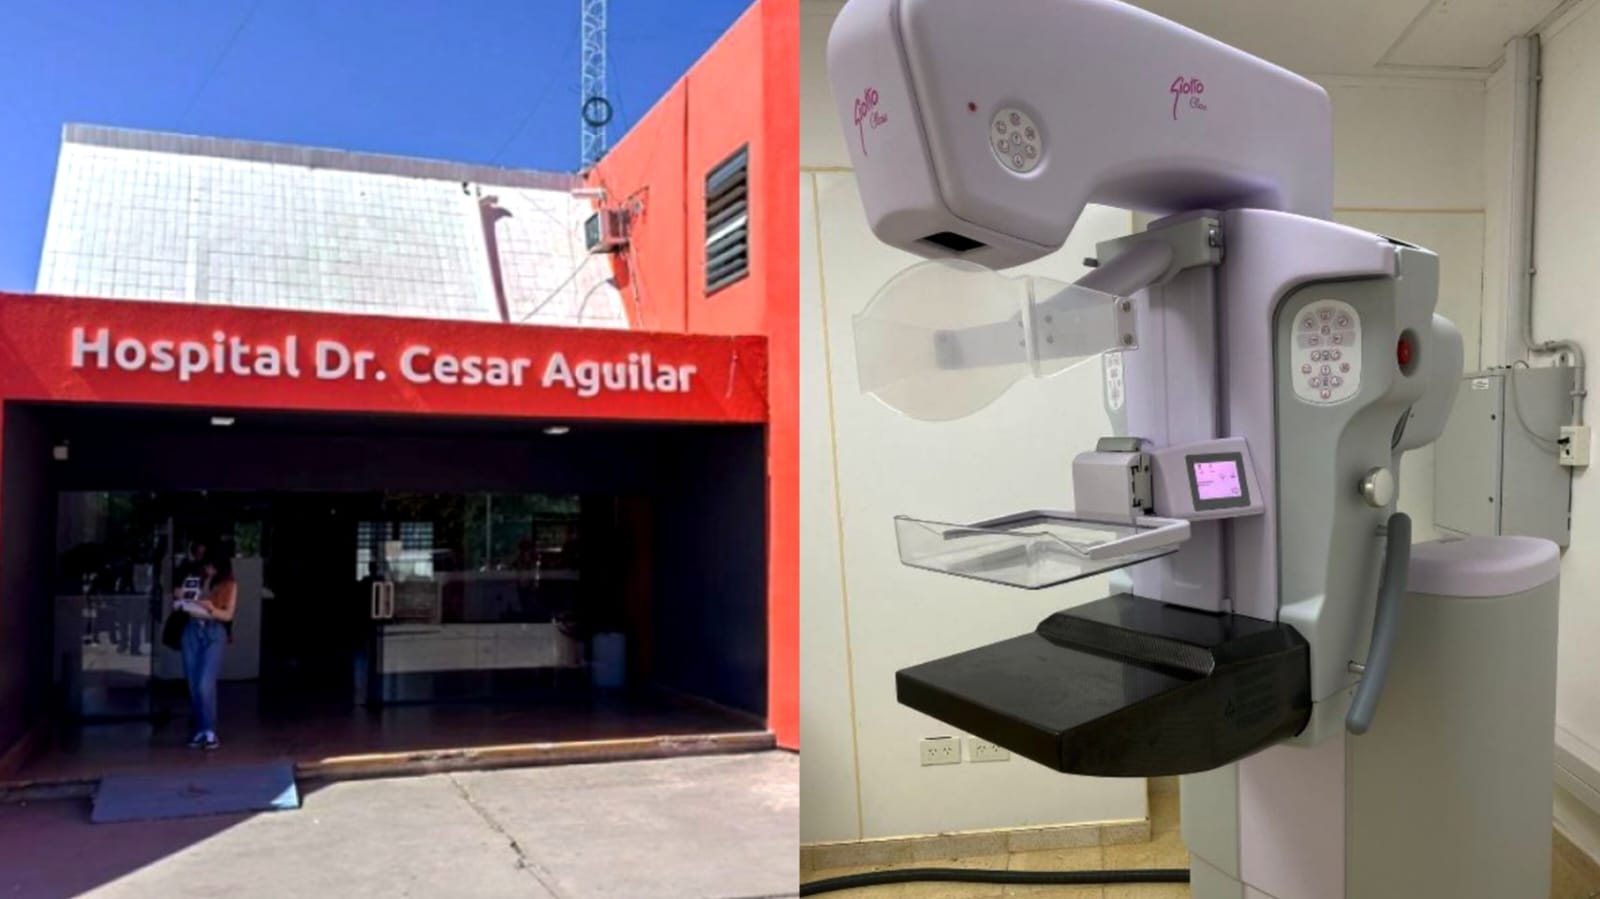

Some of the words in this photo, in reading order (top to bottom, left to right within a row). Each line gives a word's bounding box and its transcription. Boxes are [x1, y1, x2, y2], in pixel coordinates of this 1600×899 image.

[71, 325, 299, 384] Hospital
[314, 340, 387, 384] Dr.
[399, 344, 531, 391] Cesar
[541, 352, 697, 398] Aguilar
